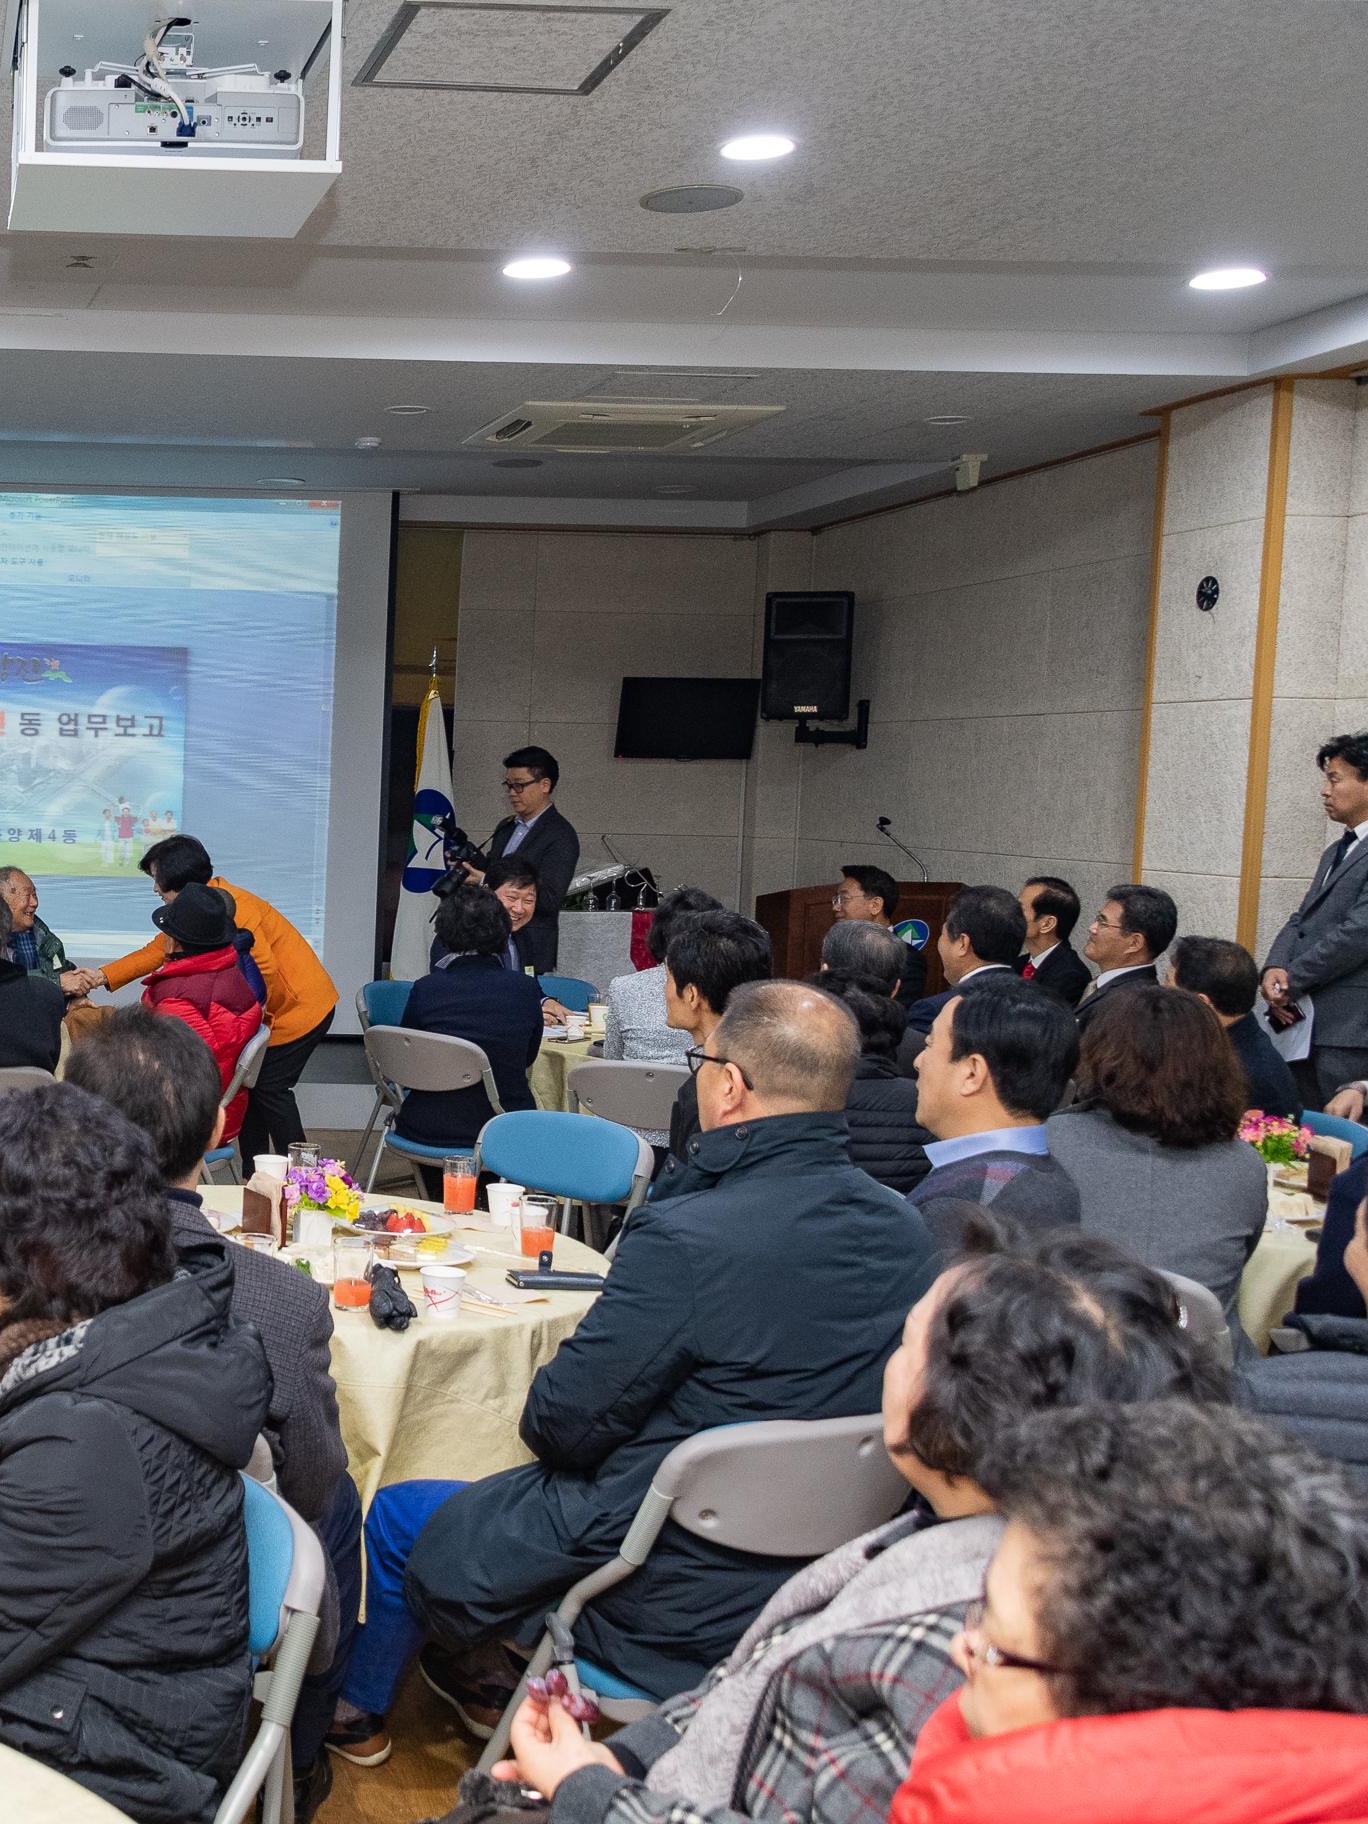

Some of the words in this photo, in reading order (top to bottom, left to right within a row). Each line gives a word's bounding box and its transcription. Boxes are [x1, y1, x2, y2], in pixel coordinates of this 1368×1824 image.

[0, 494, 33, 503] Microsoft
[34, 495, 74, 504] PowerPoint
[11, 557, 26, 566] 도구
[28, 558, 44, 567] 사용
[68, 574, 91, 583] 모니터
[793, 705, 818, 713] YAMAHA
[19, 711, 41, 737] 동
[57, 712, 164, 738] 업무보고
